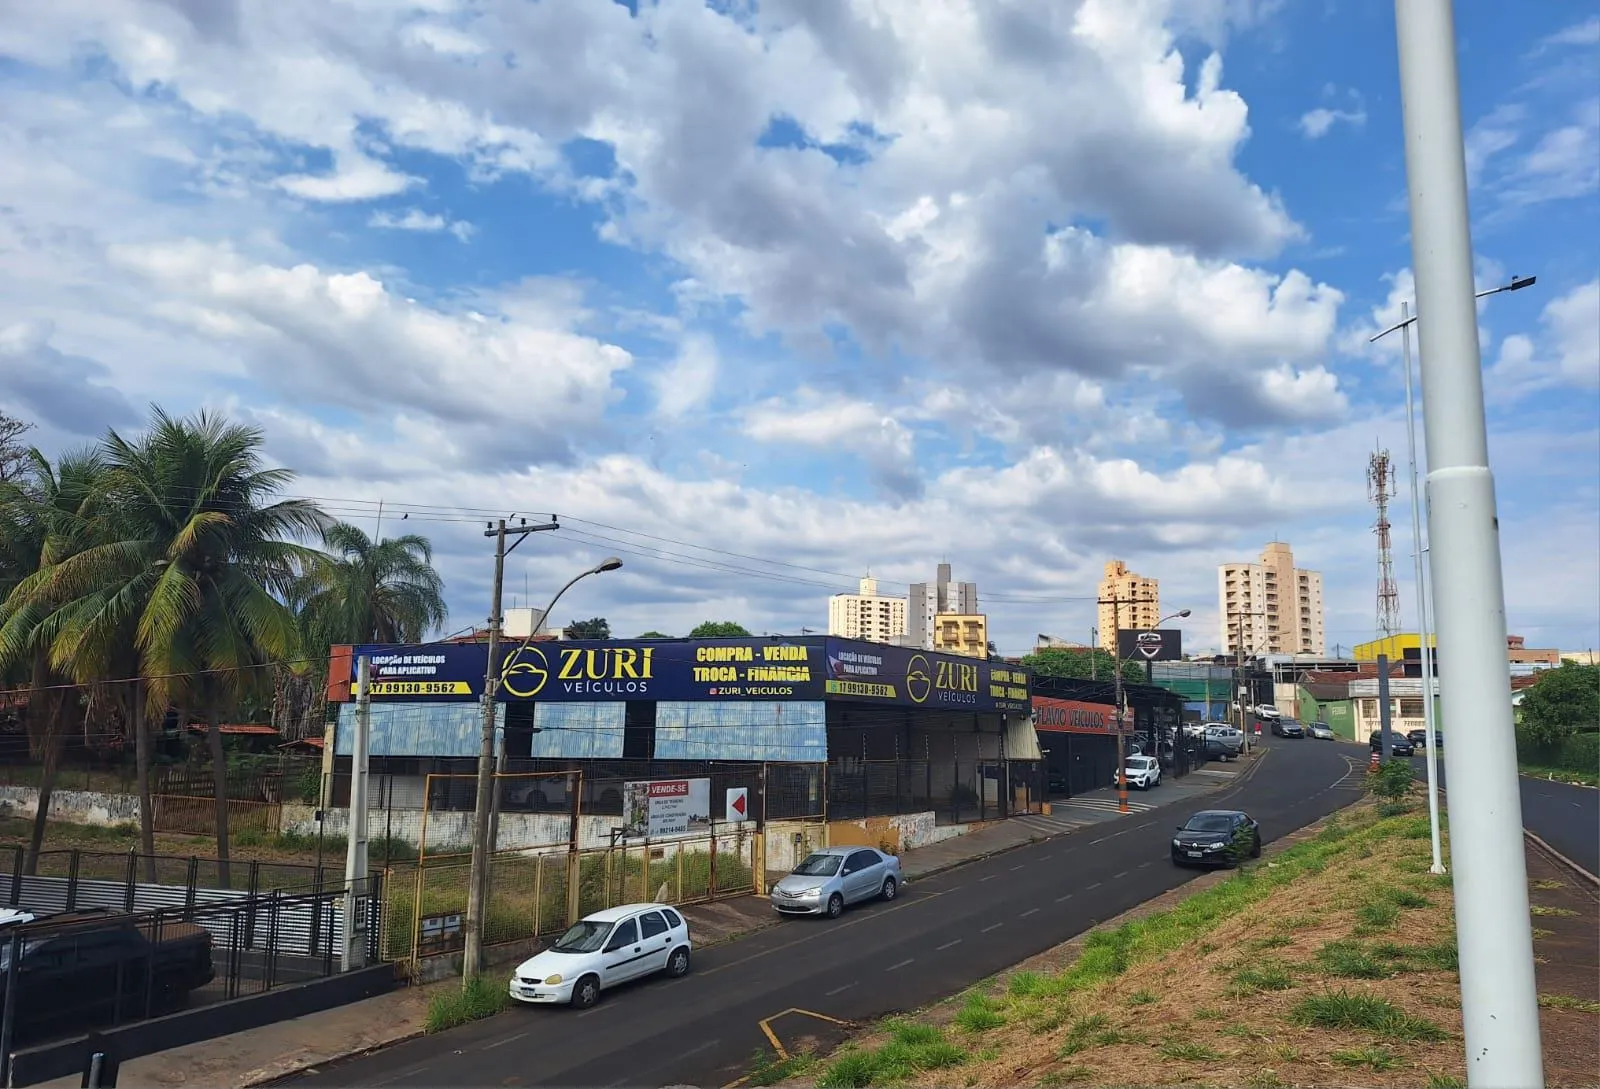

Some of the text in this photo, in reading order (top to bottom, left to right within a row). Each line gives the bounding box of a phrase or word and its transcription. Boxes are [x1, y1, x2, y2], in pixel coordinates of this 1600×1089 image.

[403, 655, 412, 664] DE
[413, 653, 445, 664] VEÍCULOS
[696, 647, 753, 661] COMPRA
[763, 646, 808, 661] VENDA
[558, 648, 655, 679] ZURI
[379, 666, 437, 675] PARA APLICATIVO
[693, 667, 737, 682] TROCA
[747, 666, 811, 681] FINANCIA
[936, 661, 978, 691] ZURI
[386, 683, 456, 693] 99130-9562
[564, 680, 648, 693] VEÍCULOS
[718, 687, 793, 696] ZURI_VEICULOS
[937, 691, 976, 704] VEÍCULOS
[651, 784, 687, 794] VENDE-SE
